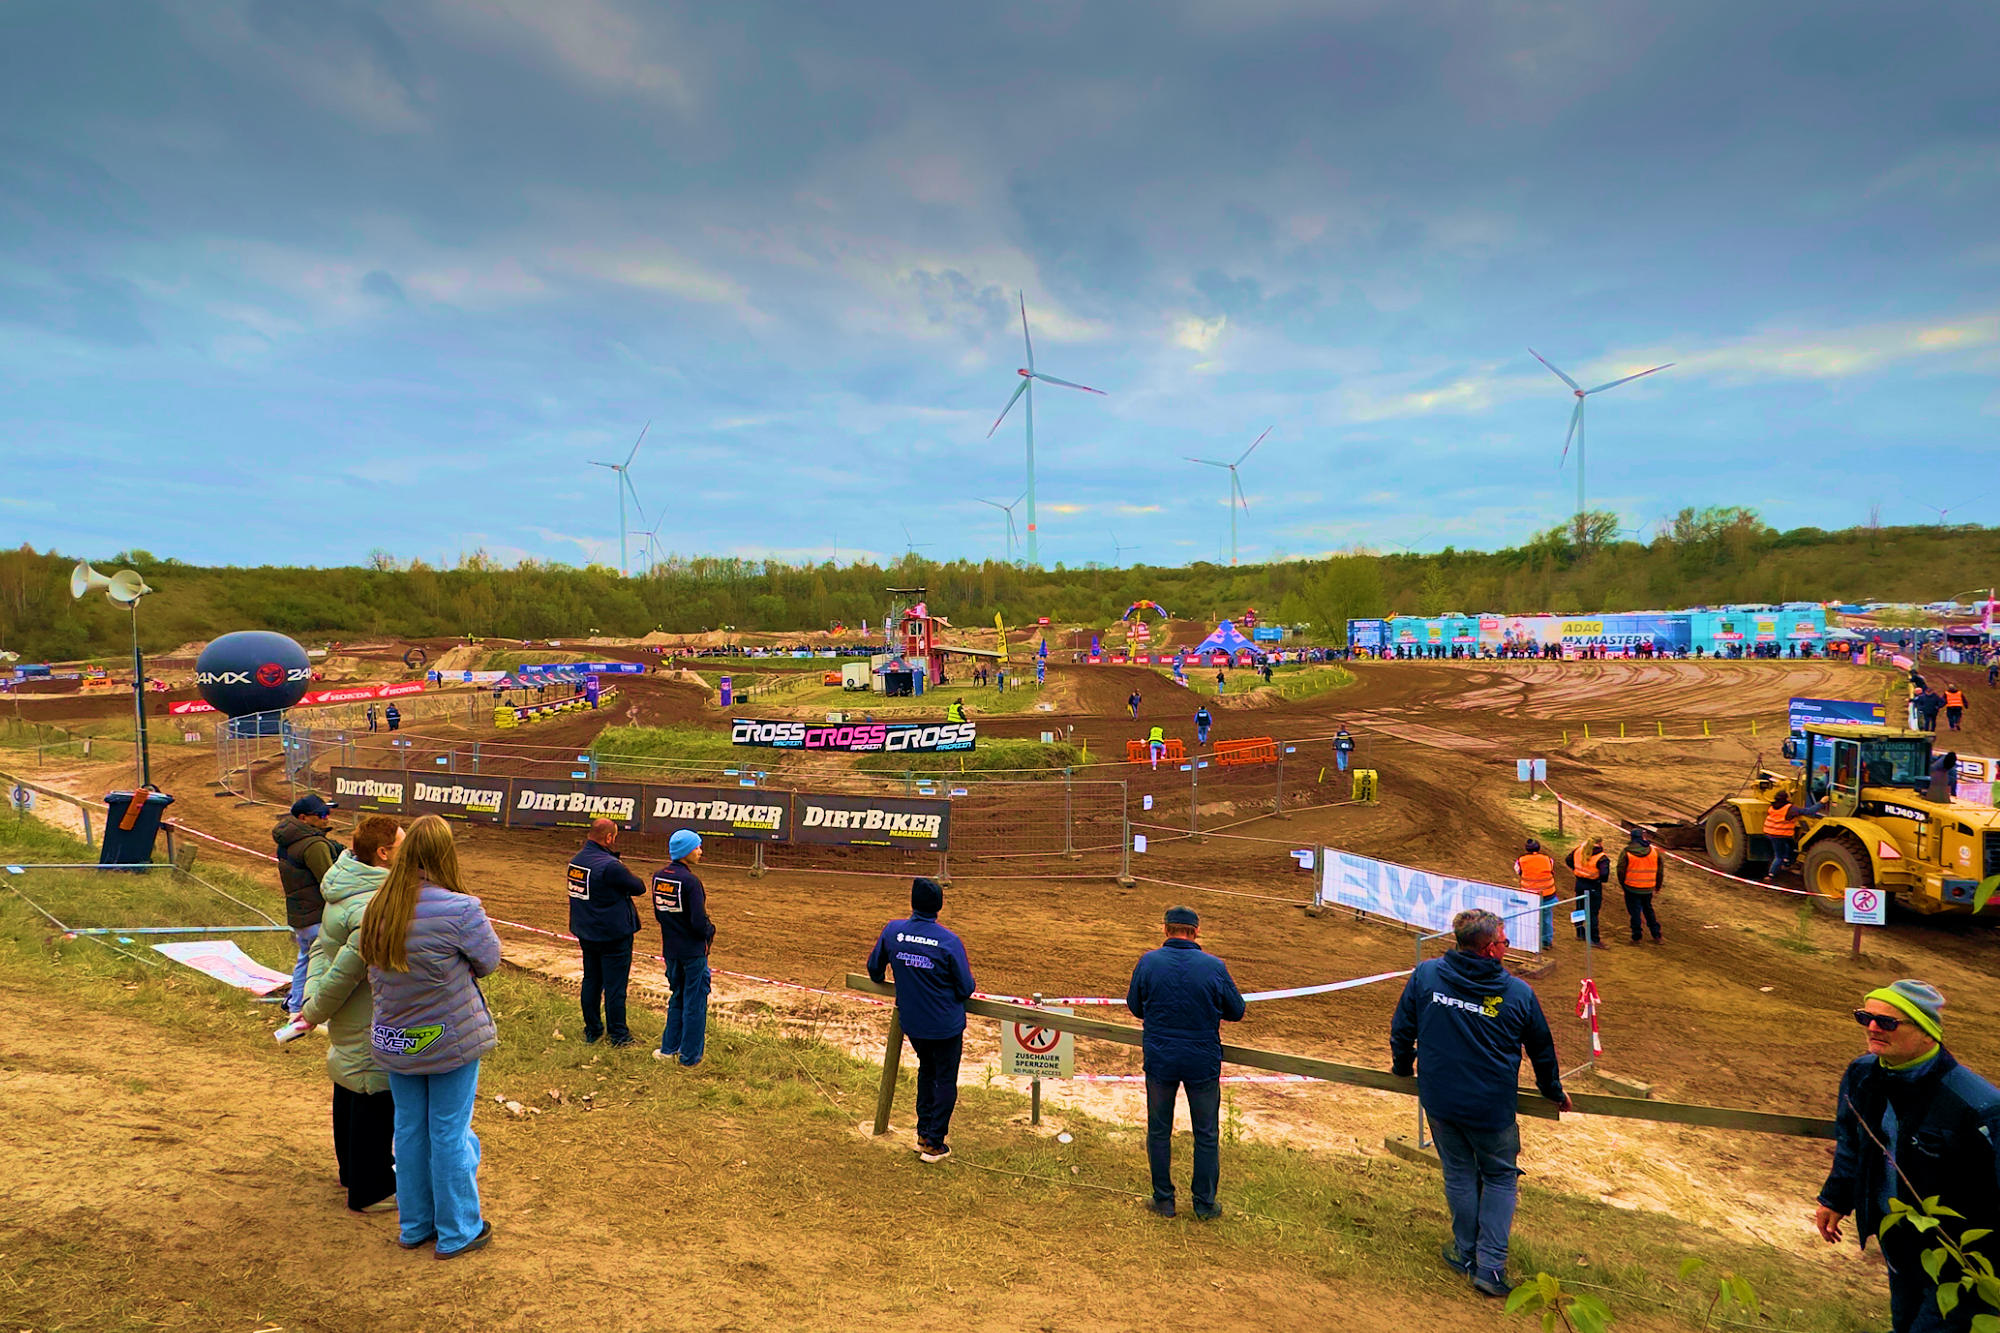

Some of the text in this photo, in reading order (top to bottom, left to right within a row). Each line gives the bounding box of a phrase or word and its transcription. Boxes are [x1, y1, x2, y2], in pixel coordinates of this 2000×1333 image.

[1563, 623, 1600, 632] ADAC
[1585, 635, 1651, 645] MASTERS
[330, 691, 373, 701] HONDA
[732, 723, 806, 743] CROSS
[805, 725, 886, 747] CROSS
[885, 722, 977, 751] CROSS
[1015, 1052, 1060, 1062] ZUSCHAUER
[1015, 1060, 1060, 1069] SPERRZONE
